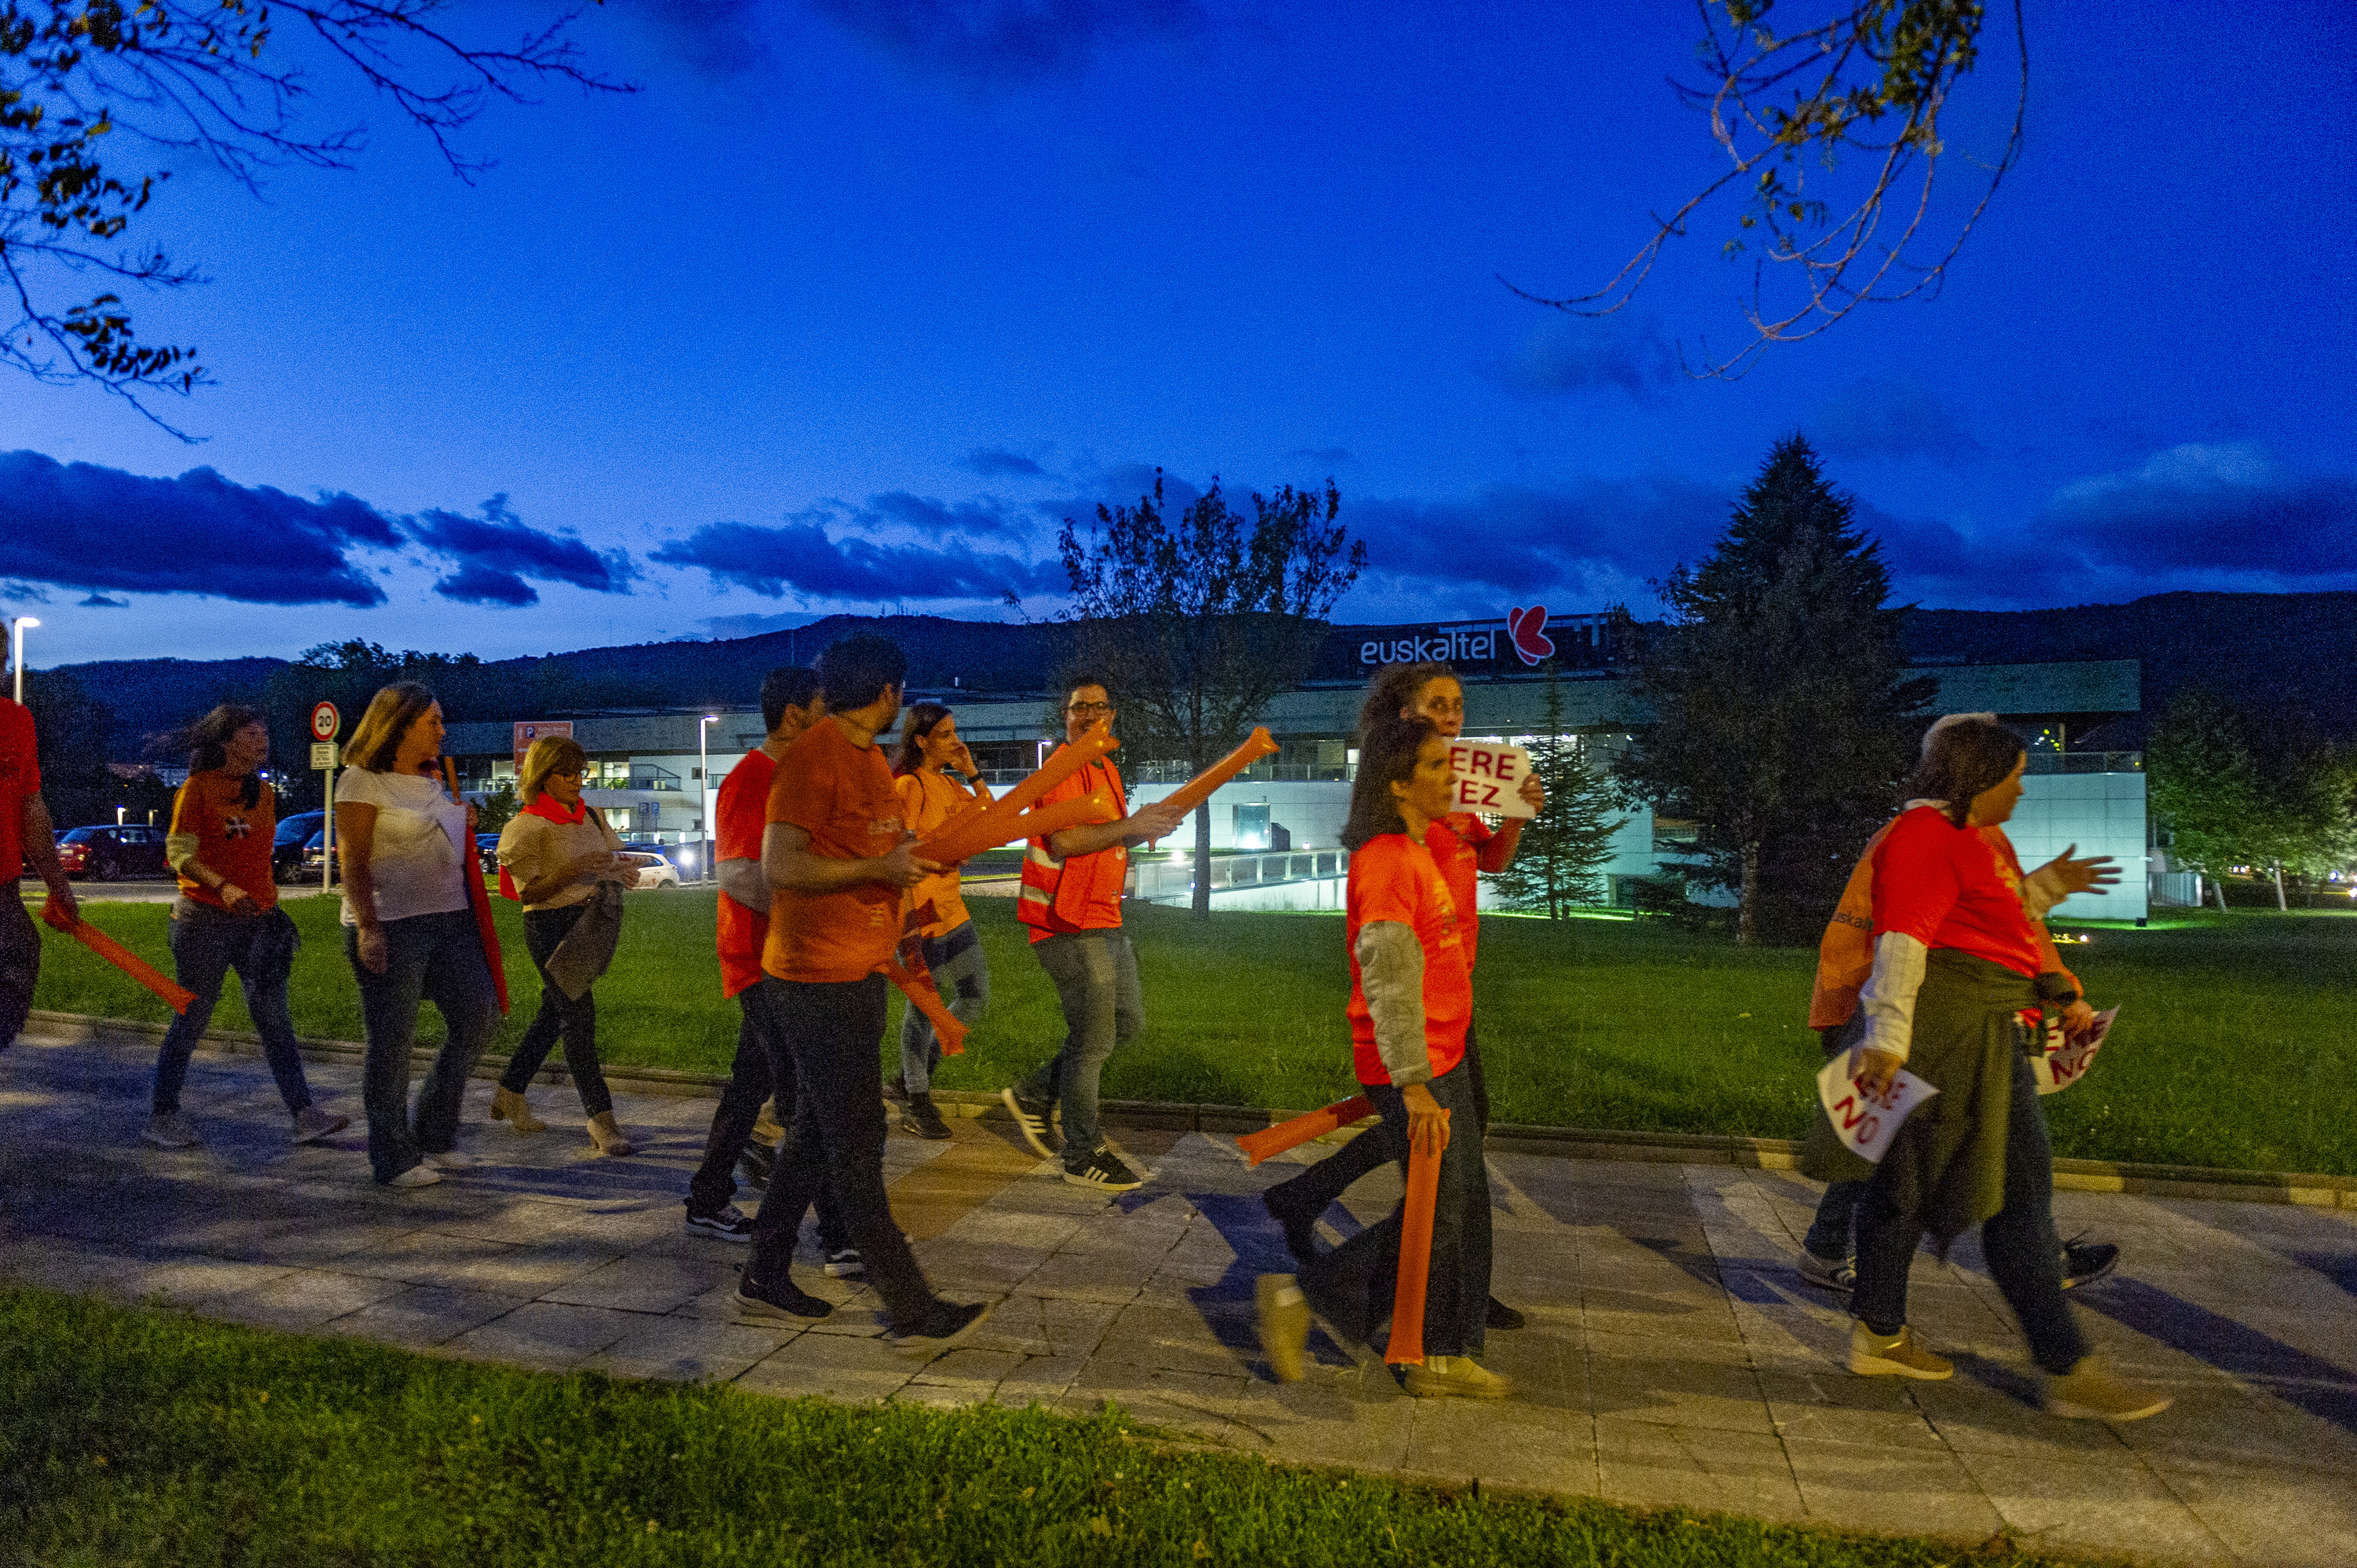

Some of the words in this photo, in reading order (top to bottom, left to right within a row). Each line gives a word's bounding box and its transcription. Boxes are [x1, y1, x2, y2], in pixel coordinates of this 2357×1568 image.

[1360, 629, 1496, 665] euskaltel
[317, 715, 332, 727] 20
[526, 727, 534, 738] P
[1450, 746, 1516, 781] ERE
[1460, 779, 1501, 808] EZ
[1833, 1094, 1880, 1145] NO
